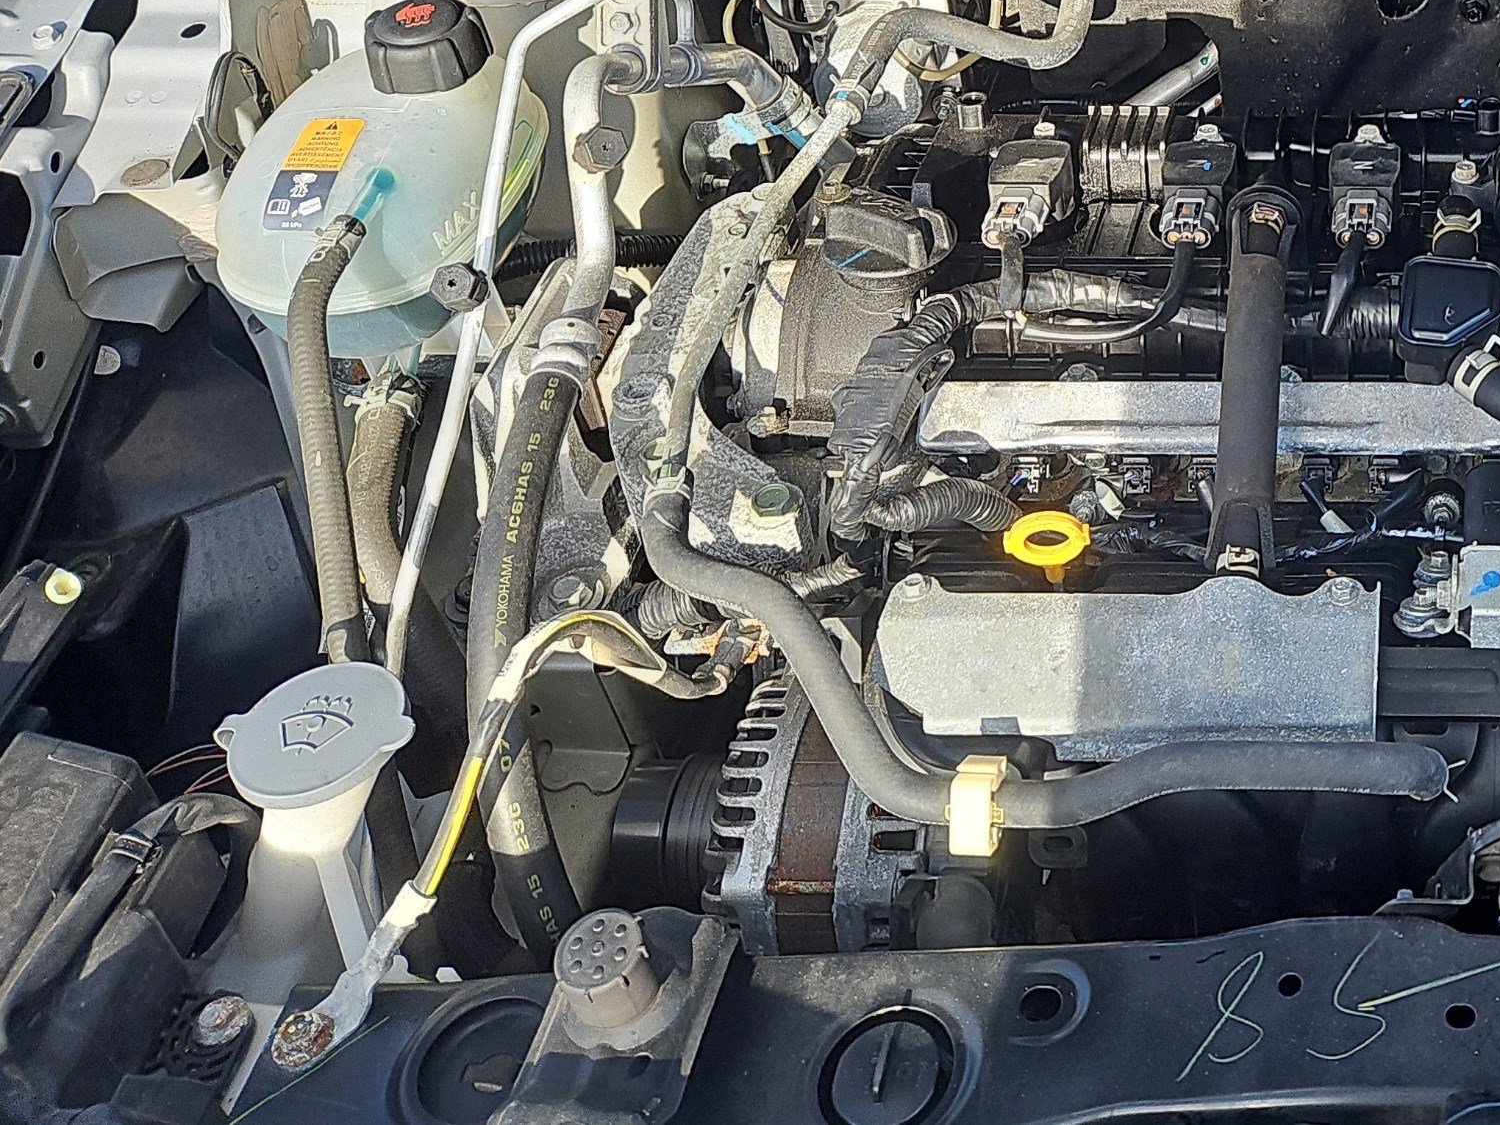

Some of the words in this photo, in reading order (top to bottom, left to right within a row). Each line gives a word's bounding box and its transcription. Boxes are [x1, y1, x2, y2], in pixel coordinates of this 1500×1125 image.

[496, 554, 514, 627] YOKOHAMA
[527, 432, 541, 453] 15
[539, 376, 560, 411] 23G
[508, 801, 531, 854] 23G
[527, 873, 544, 900] 15
